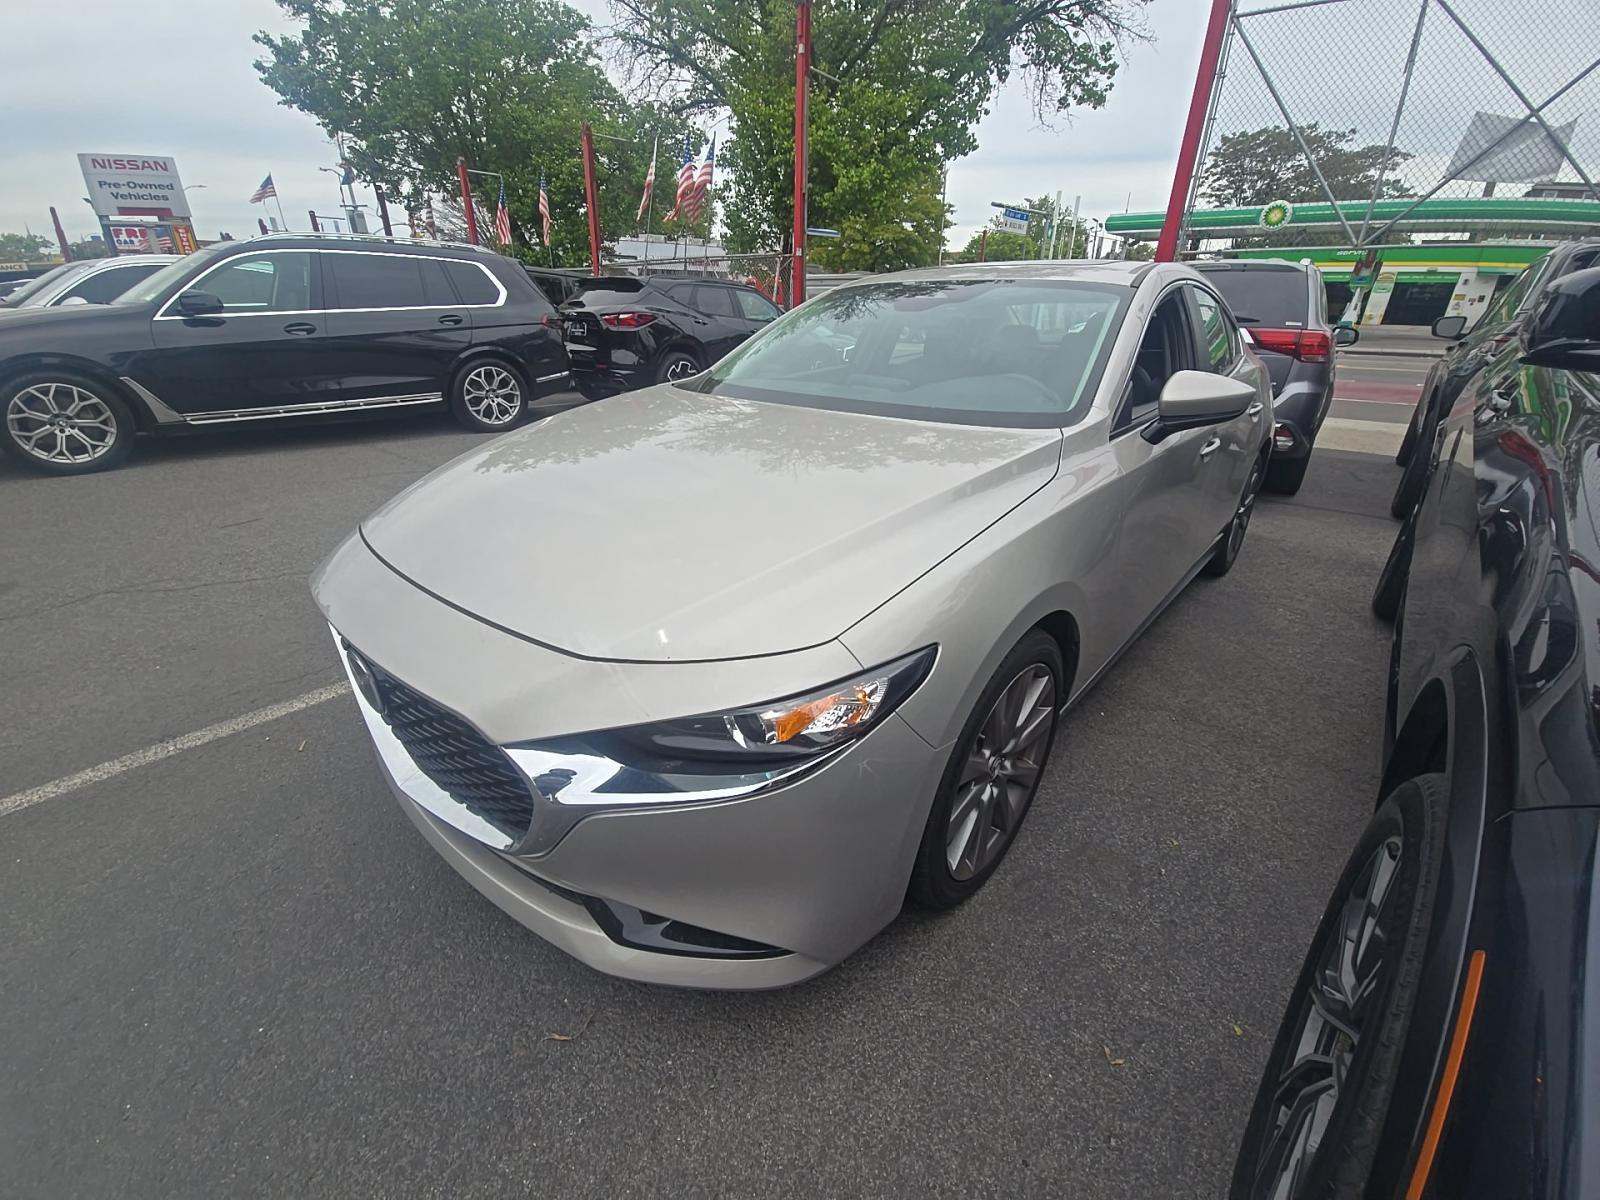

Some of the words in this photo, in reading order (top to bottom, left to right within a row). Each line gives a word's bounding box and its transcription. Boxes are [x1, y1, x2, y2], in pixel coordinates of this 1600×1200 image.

[91, 158, 169, 172] NISSAN
[97, 180, 175, 191] Pre-Owned
[110, 192, 170, 201] Vehicles
